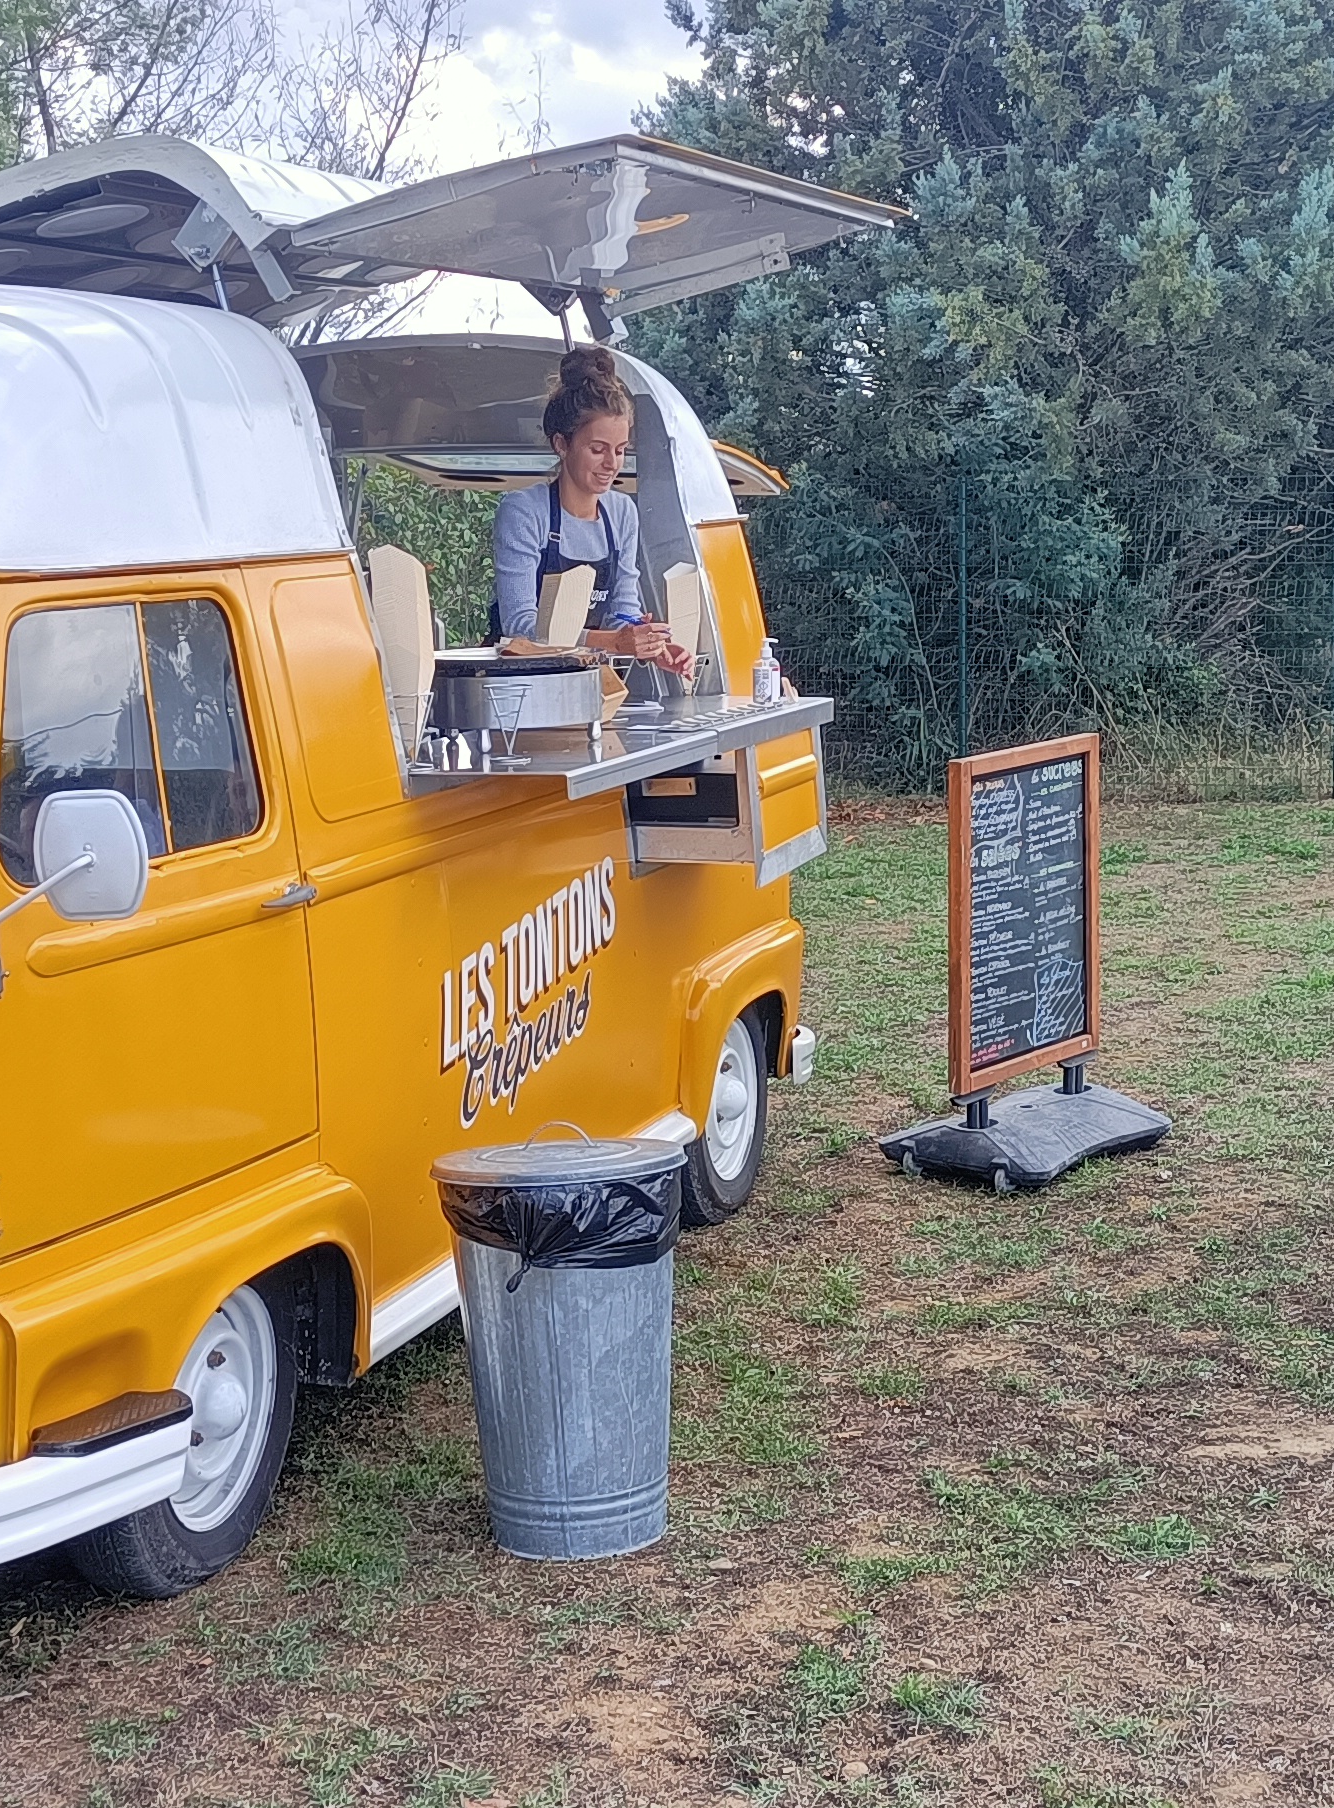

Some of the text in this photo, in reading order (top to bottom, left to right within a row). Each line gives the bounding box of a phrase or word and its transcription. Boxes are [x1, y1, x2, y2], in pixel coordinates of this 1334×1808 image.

[441, 856, 616, 1072] LES TONTONS
[461, 968, 592, 1129] Crêpeurs
